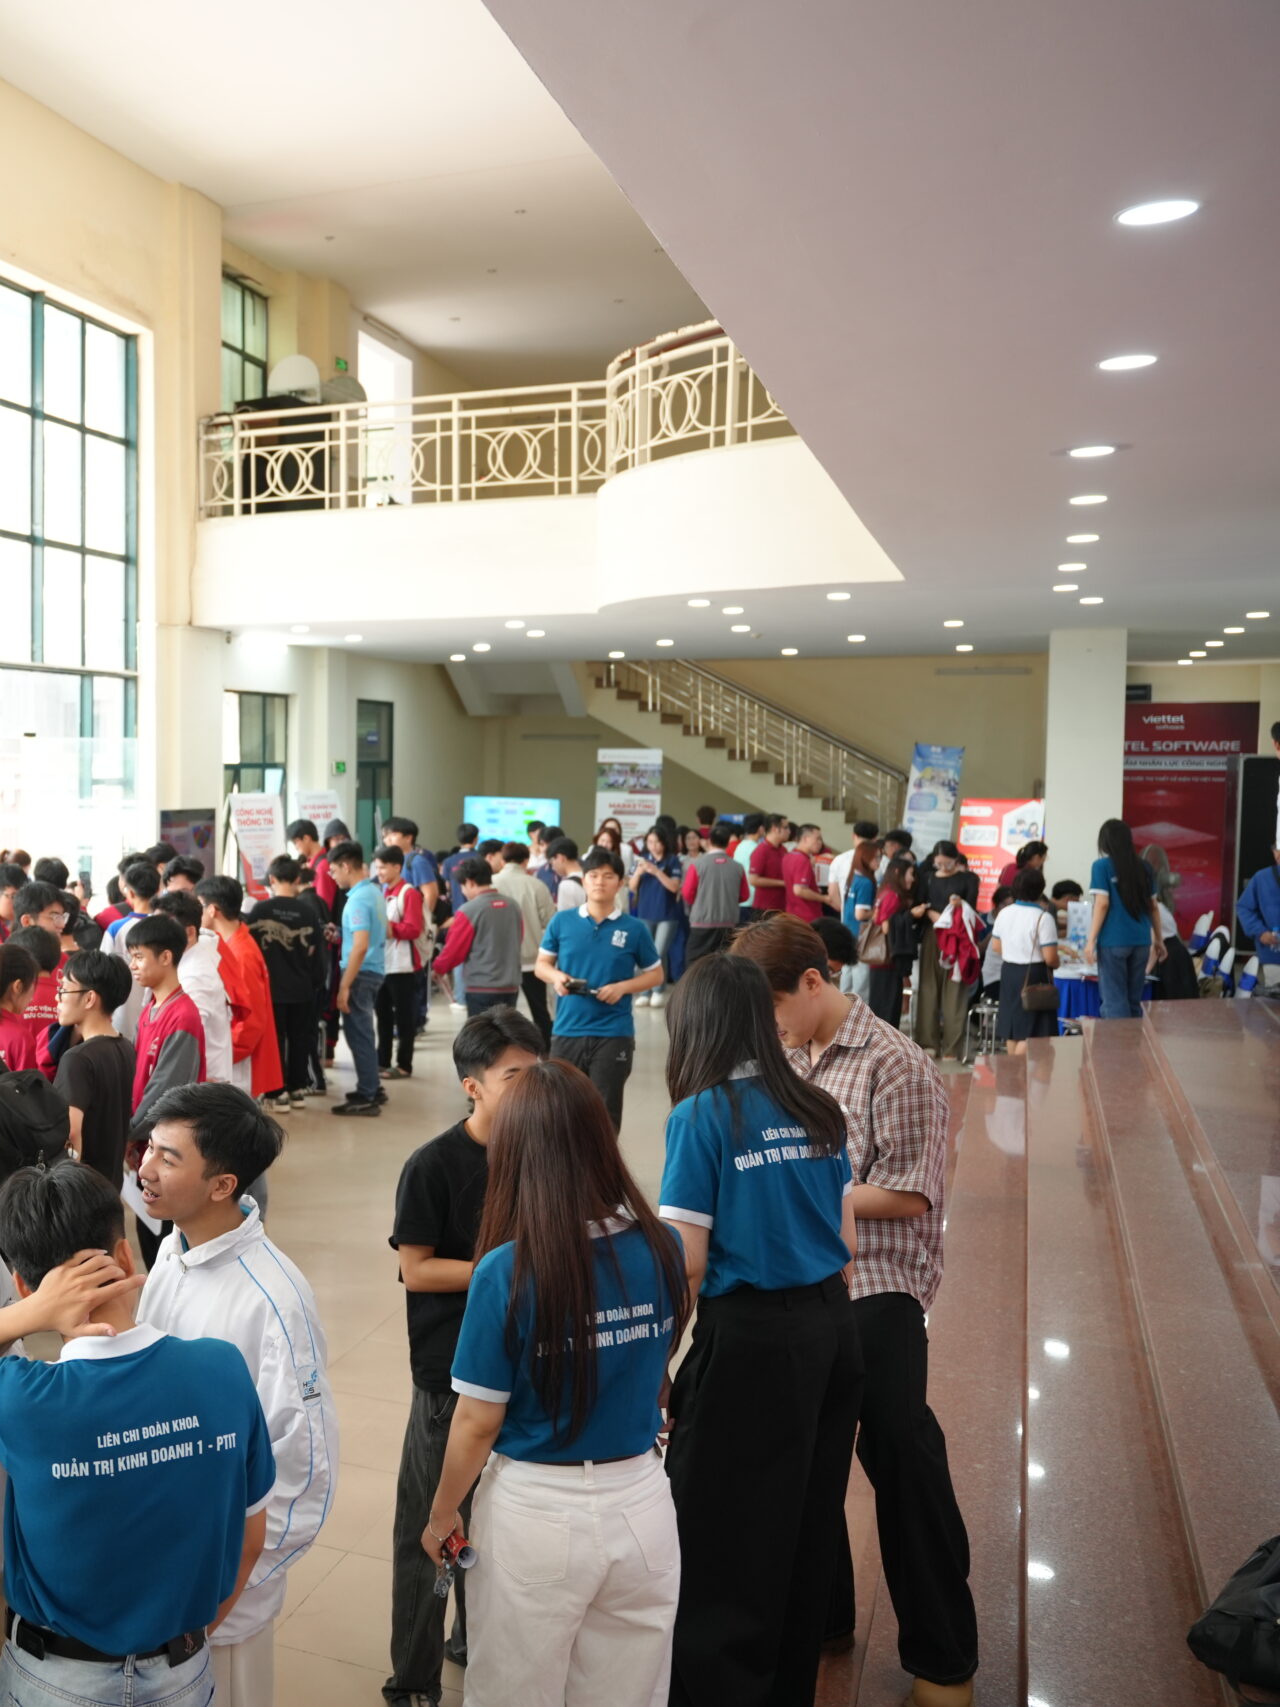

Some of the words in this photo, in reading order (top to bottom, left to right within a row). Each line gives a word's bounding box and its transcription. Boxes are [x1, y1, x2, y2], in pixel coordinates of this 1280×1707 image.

[1142, 714, 1185, 724] viettel
[1152, 740, 1241, 752] SOFTWARE
[234, 806, 254, 817] CÔNG
[236, 816, 262, 826] THÔNG
[263, 817, 274, 826] TIN
[761, 1127, 780, 1141] LIÊN
[734, 1149, 764, 1172] QUẢN
[763, 1147, 782, 1164] TRỊ
[606, 1306, 630, 1322] ĐOÀN
[632, 1303, 654, 1318] KHOA
[616, 1323, 650, 1345] DOANH
[652, 1323, 659, 1338] 1
[97, 1432, 121, 1449] LIÊN
[122, 1429, 140, 1444] CHI
[142, 1421, 170, 1439] ĐOÀN
[172, 1415, 200, 1433] KHOA
[51, 1458, 89, 1480] QUẢN
[93, 1459, 115, 1477] TRỊ
[117, 1451, 148, 1472] KINH
[151, 1442, 193, 1465] DOANH
[196, 1440, 203, 1455] 1
[216, 1433, 237, 1452] PTIT
